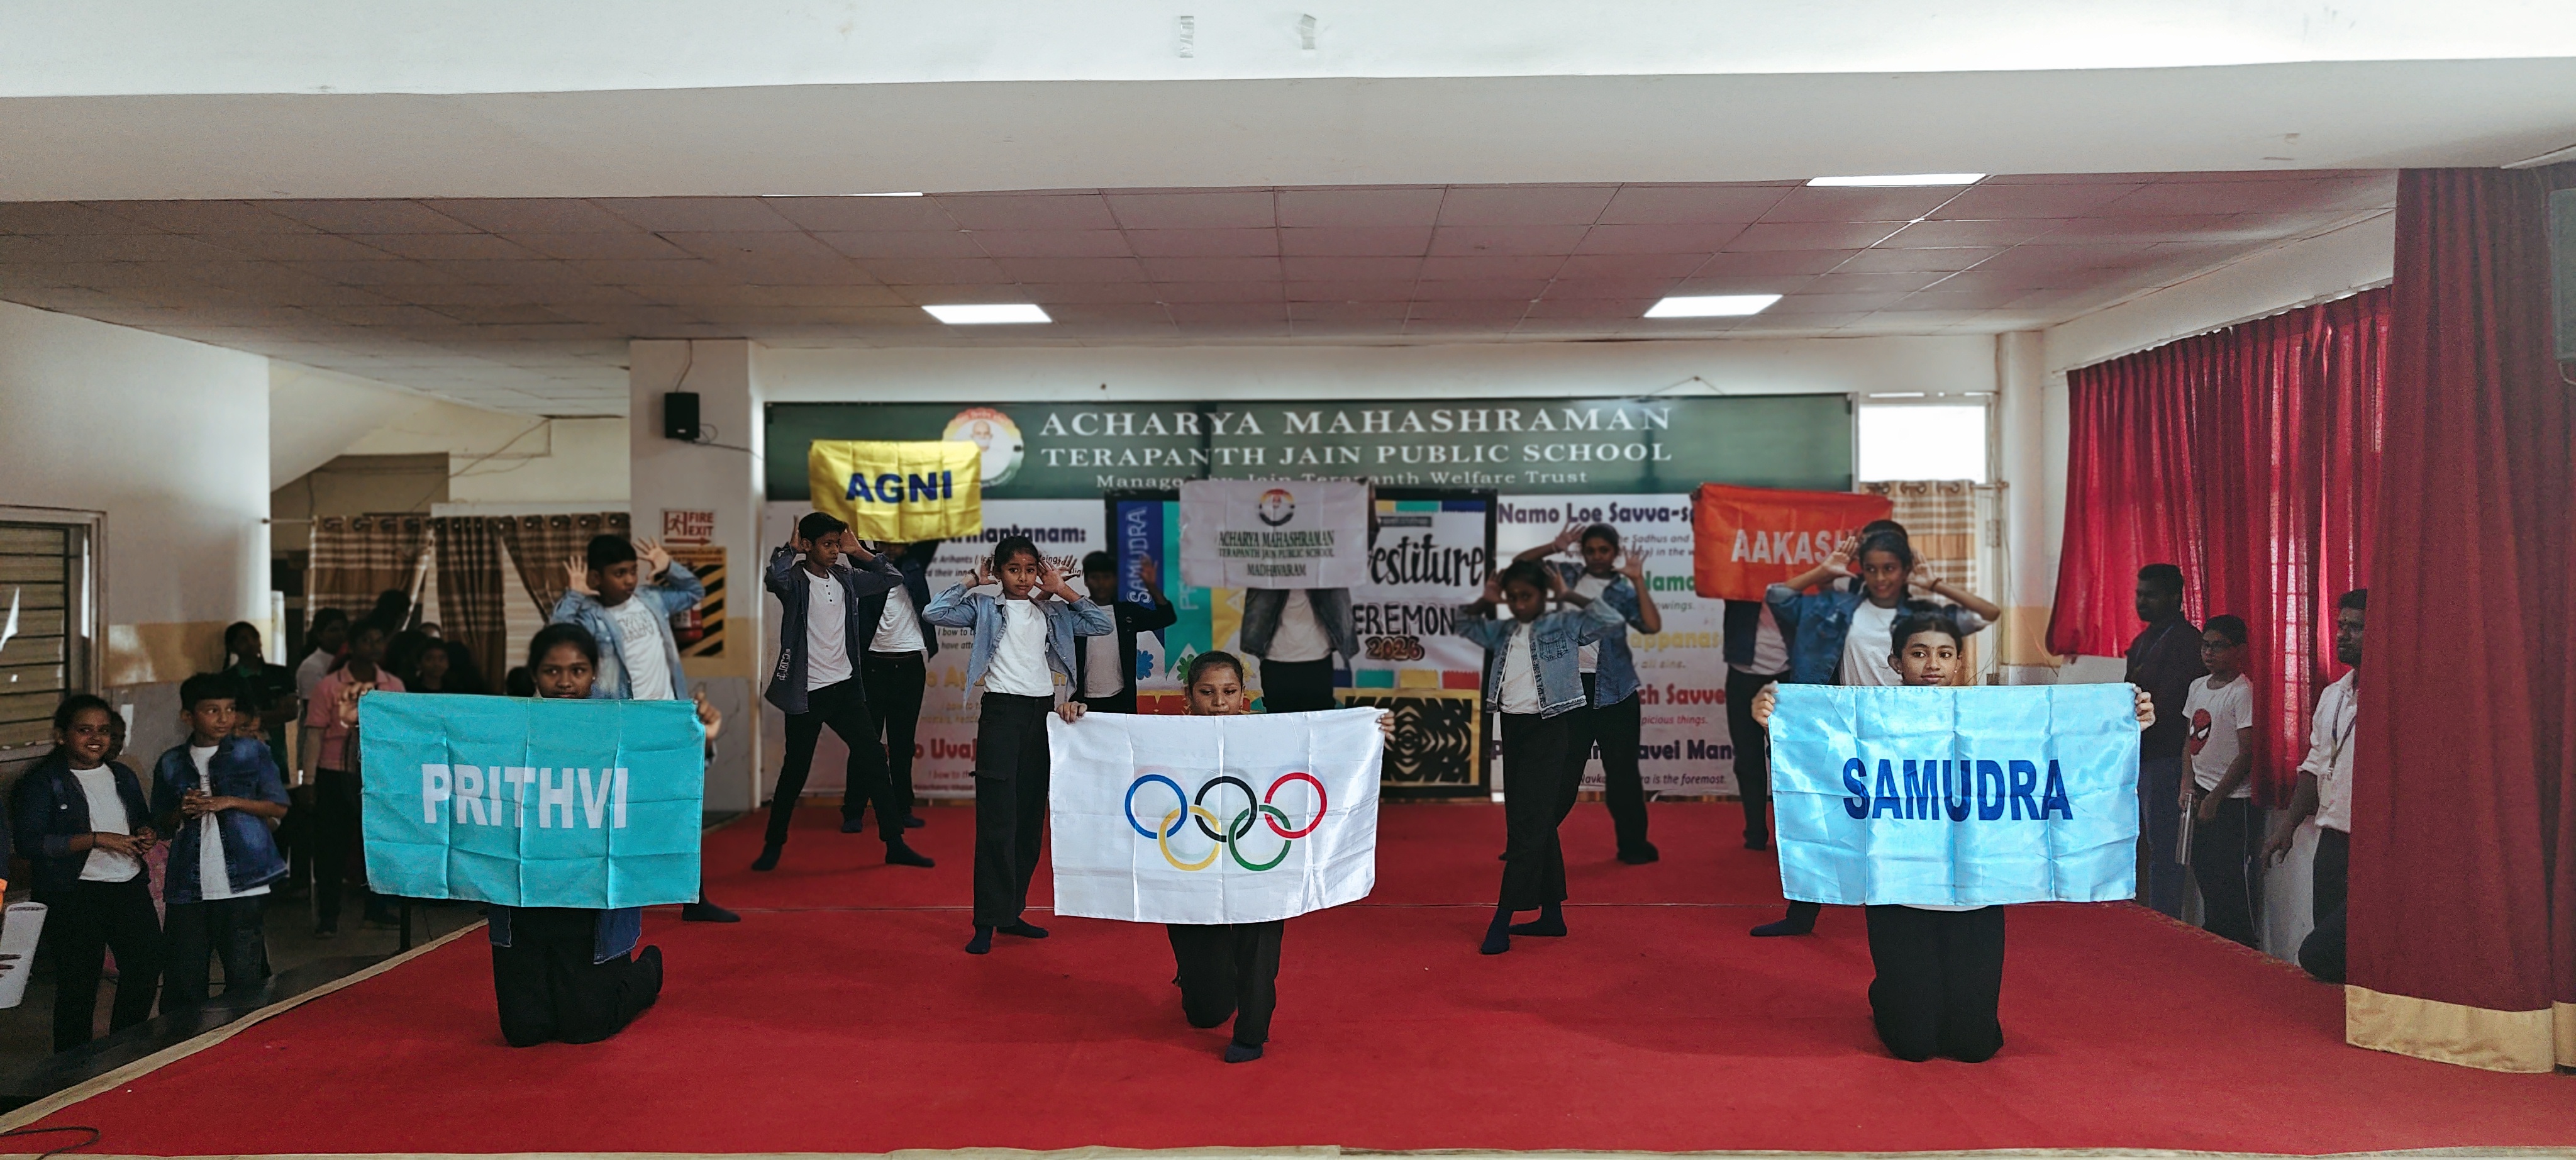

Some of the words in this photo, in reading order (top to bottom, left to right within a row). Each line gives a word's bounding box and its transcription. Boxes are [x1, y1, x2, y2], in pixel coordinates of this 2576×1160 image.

[1039, 412, 1263, 436] ACHARYA
[1284, 408, 1672, 434] MAHASHRAMAN
[1041, 447, 1265, 466] TERAPANTH
[1279, 446, 1361, 465] JAIN
[1377, 445, 1509, 464] PUBLIC
[1523, 442, 1672, 462] SCHOOL
[845, 470, 952, 503] AGNI
[1096, 474, 1196, 491] Manage
[1430, 471, 1516, 484] Welfare
[1525, 471, 1588, 483] Trust
[688, 512, 714, 523] FIRE
[1498, 503, 1560, 523] Namo
[1567, 503, 1602, 523] Loe
[1609, 503, 1694, 523] Savva-s
[689, 526, 714, 535] EXIT
[1219, 532, 1260, 547] ACHARYA
[1262, 530, 1335, 547] MAHASHRAMAN
[1219, 548, 1260, 557] TERAPANTH
[1262, 548, 1276, 560] JAIN
[1279, 548, 1303, 557] PUBLIC
[1305, 548, 1335, 558] SCHOOL
[1370, 533, 1484, 587] estiture
[1247, 564, 1306, 577] MADHAVARAM
[1353, 604, 1455, 635] EREMON
[943, 627, 958, 636] bow
[1365, 636, 1426, 661] 2026
[1677, 715, 1708, 726] things.
[1653, 774, 1661, 784] is
[1663, 774, 1679, 784] the
[1680, 773, 1726, 786] foremost.
[1843, 757, 2074, 822] SAMUDRA
[421, 763, 628, 828] PRITHVI
